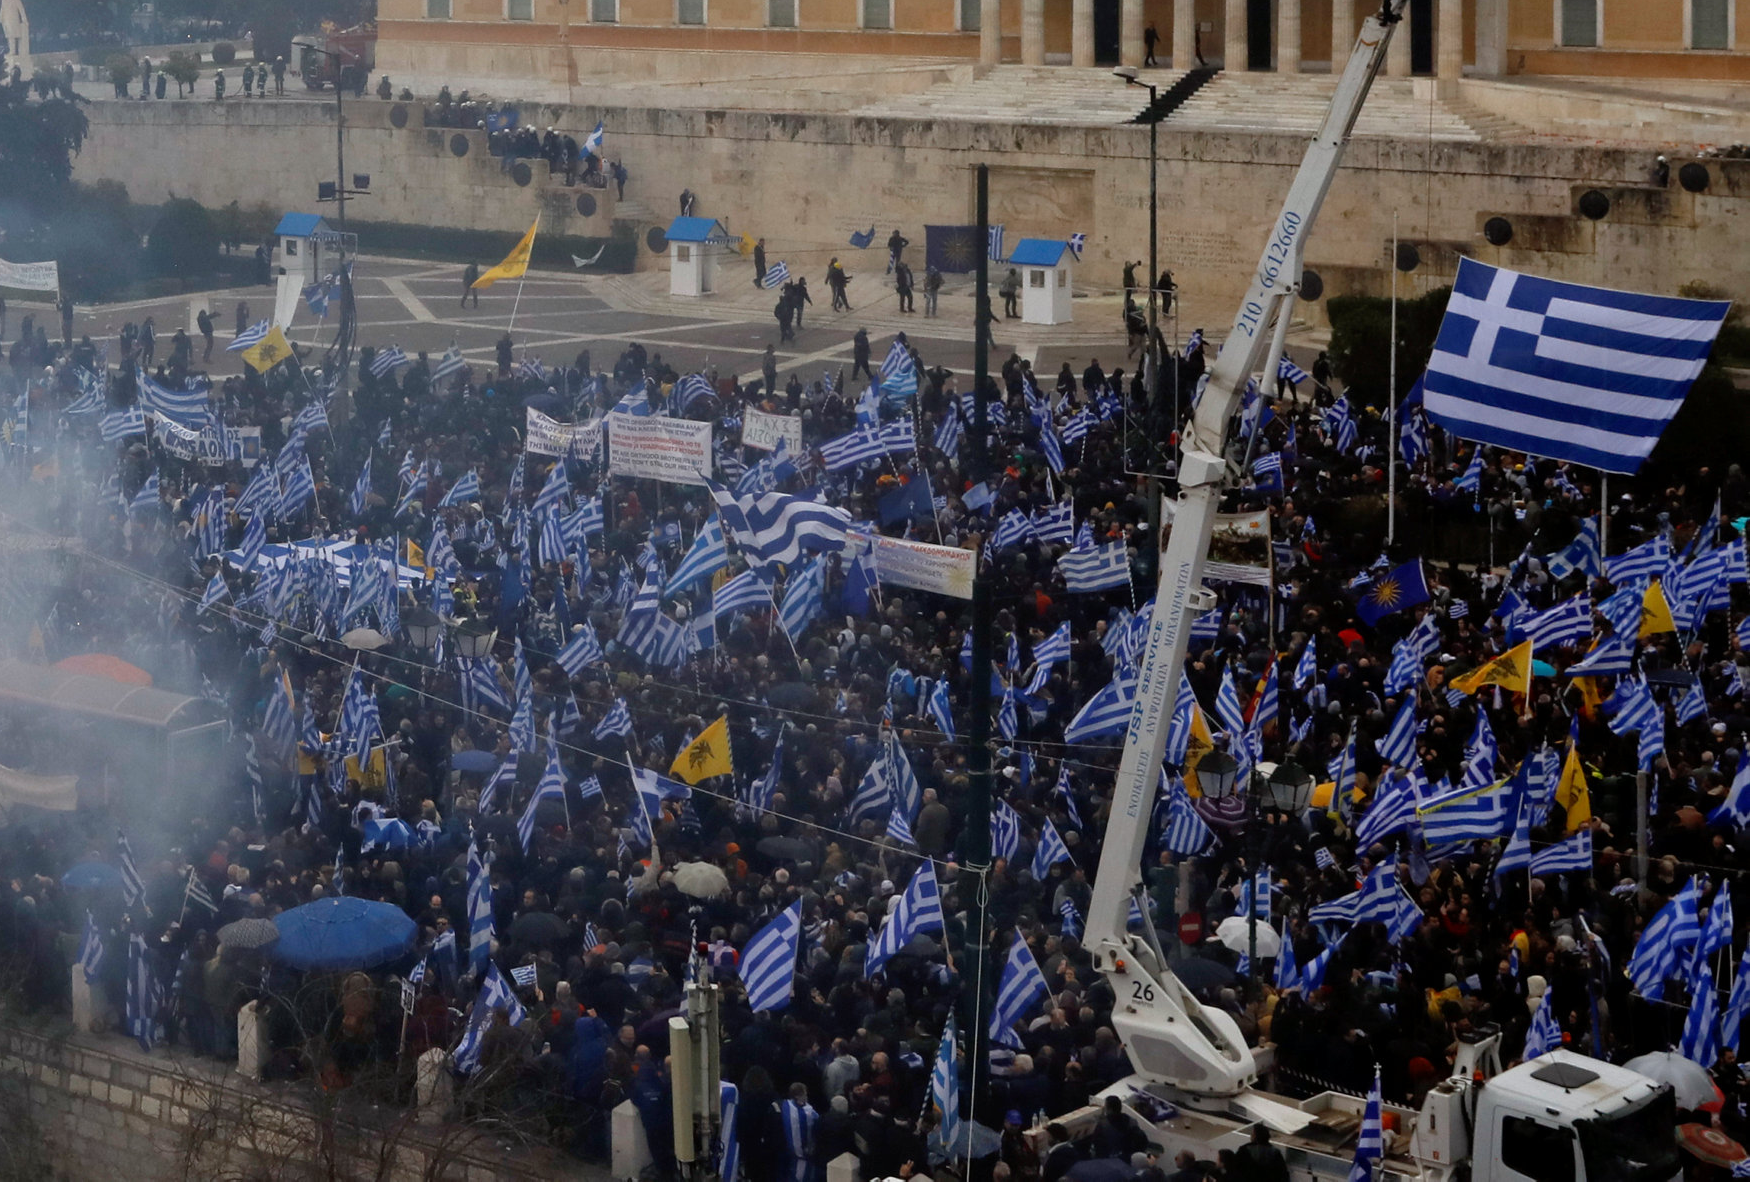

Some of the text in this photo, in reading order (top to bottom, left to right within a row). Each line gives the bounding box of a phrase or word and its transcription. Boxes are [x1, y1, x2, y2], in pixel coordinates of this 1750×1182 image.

[1237, 301, 1263, 337] 210
[1259, 211, 1302, 289] 6612660
[1129, 621, 1163, 745] JSP SERVICE
[1146, 661, 1169, 736] ΑΝΥΨΩΤΙΚΩΝ
[1164, 560, 1192, 649] ΜΗΧΑΝΗΜΑΤΩΝ
[1132, 981, 1154, 1002] 26
